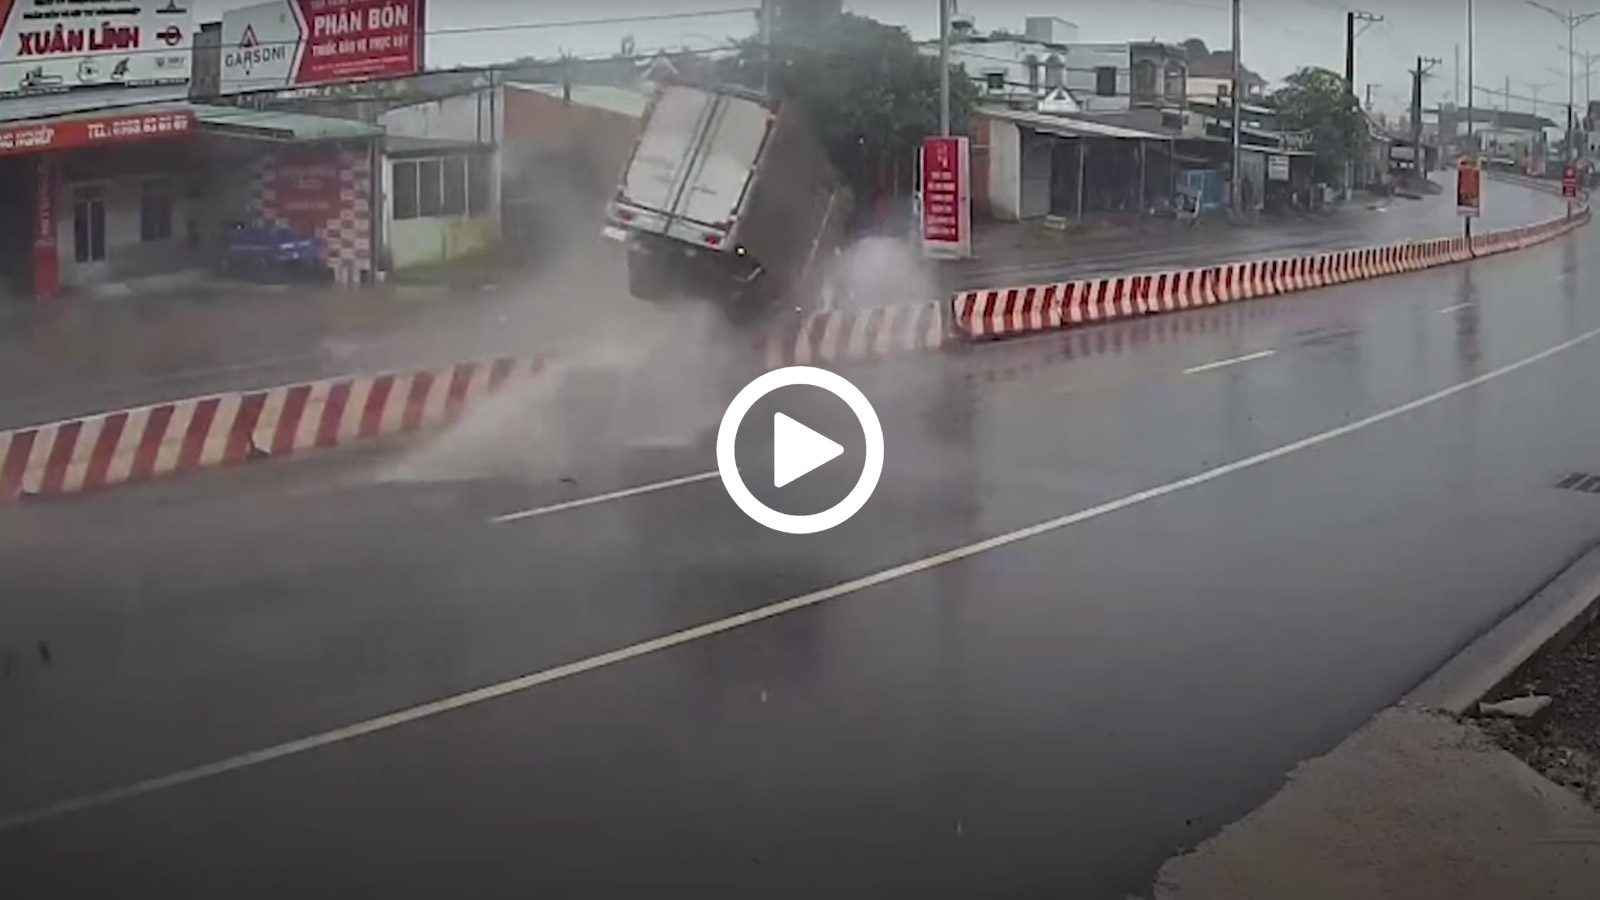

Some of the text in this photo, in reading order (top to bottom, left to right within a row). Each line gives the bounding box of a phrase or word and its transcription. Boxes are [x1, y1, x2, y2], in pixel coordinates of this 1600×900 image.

[313, 7, 362, 37] PHÂN
[18, 23, 84, 56] XUÂN
[225, 46, 286, 69] GARSONI
